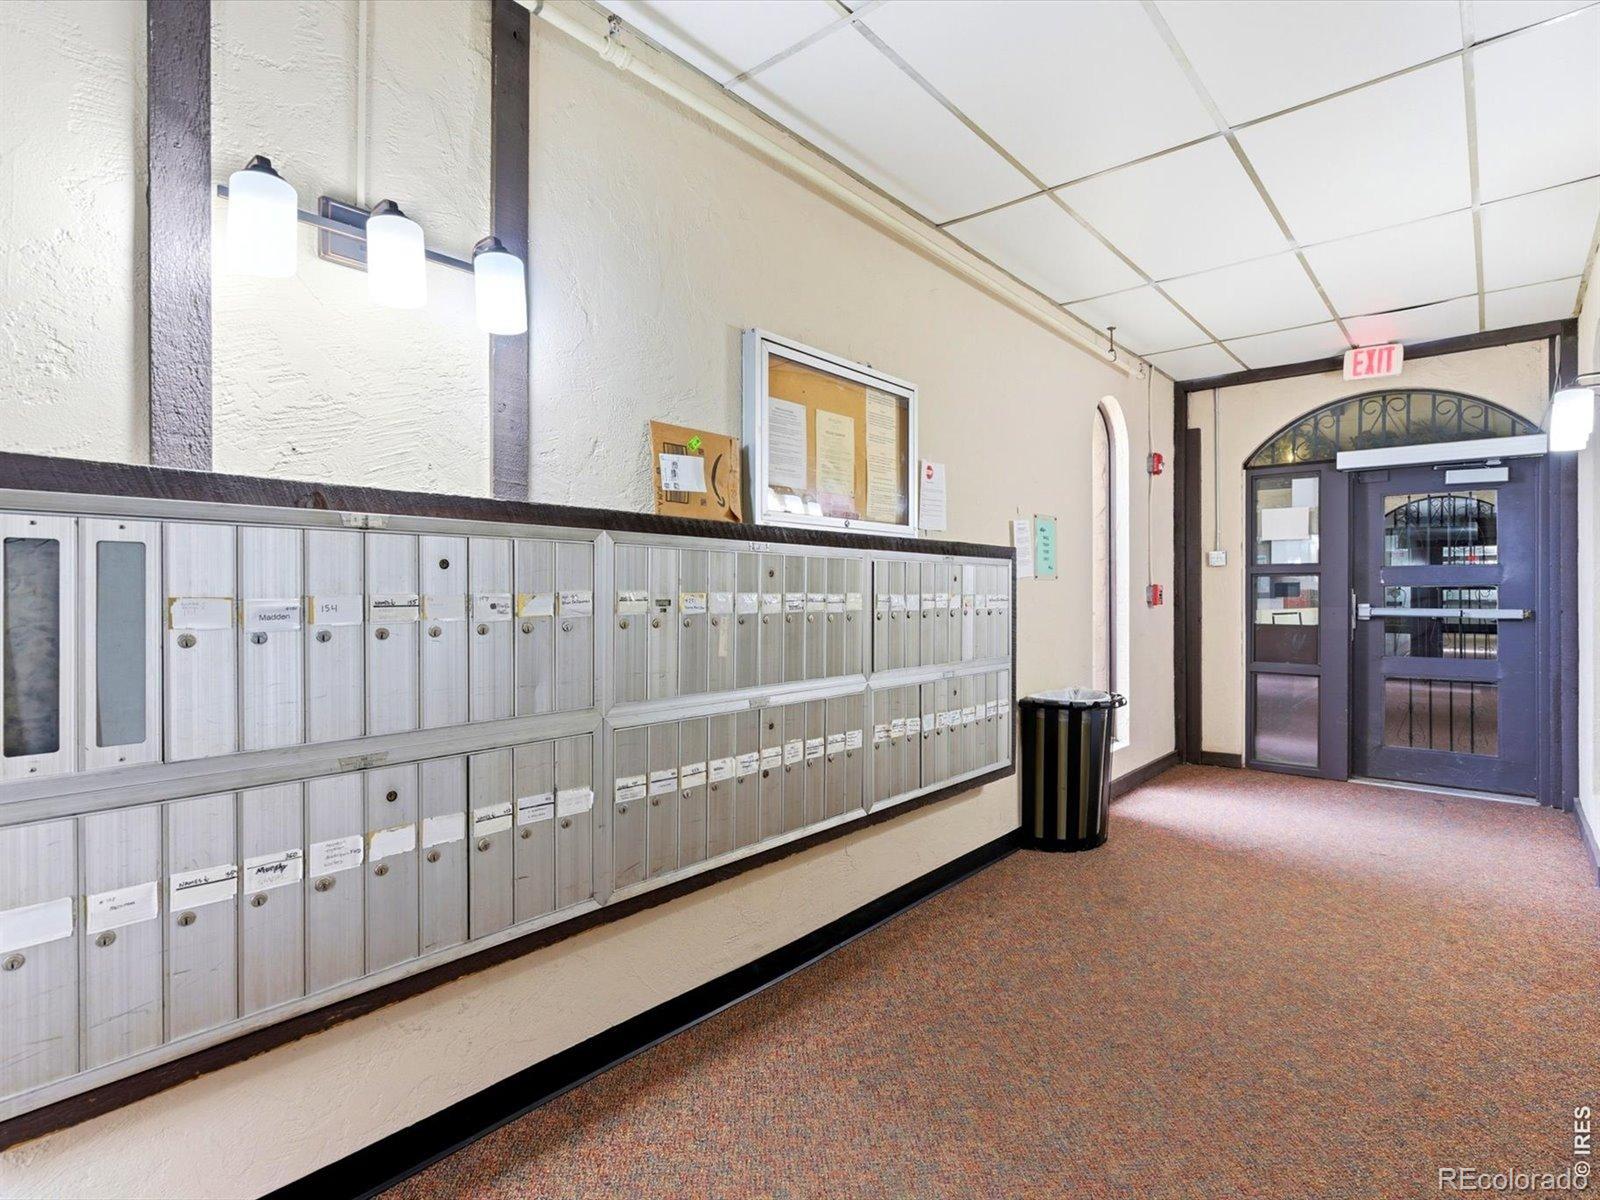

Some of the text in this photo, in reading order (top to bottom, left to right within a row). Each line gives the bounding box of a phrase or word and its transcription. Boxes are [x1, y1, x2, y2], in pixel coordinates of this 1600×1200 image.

[1352, 346, 1395, 376] EXIT
[321, 604, 338, 613] 154
[258, 613, 290, 621] Madden
[255, 863, 288, 875] Murphy
